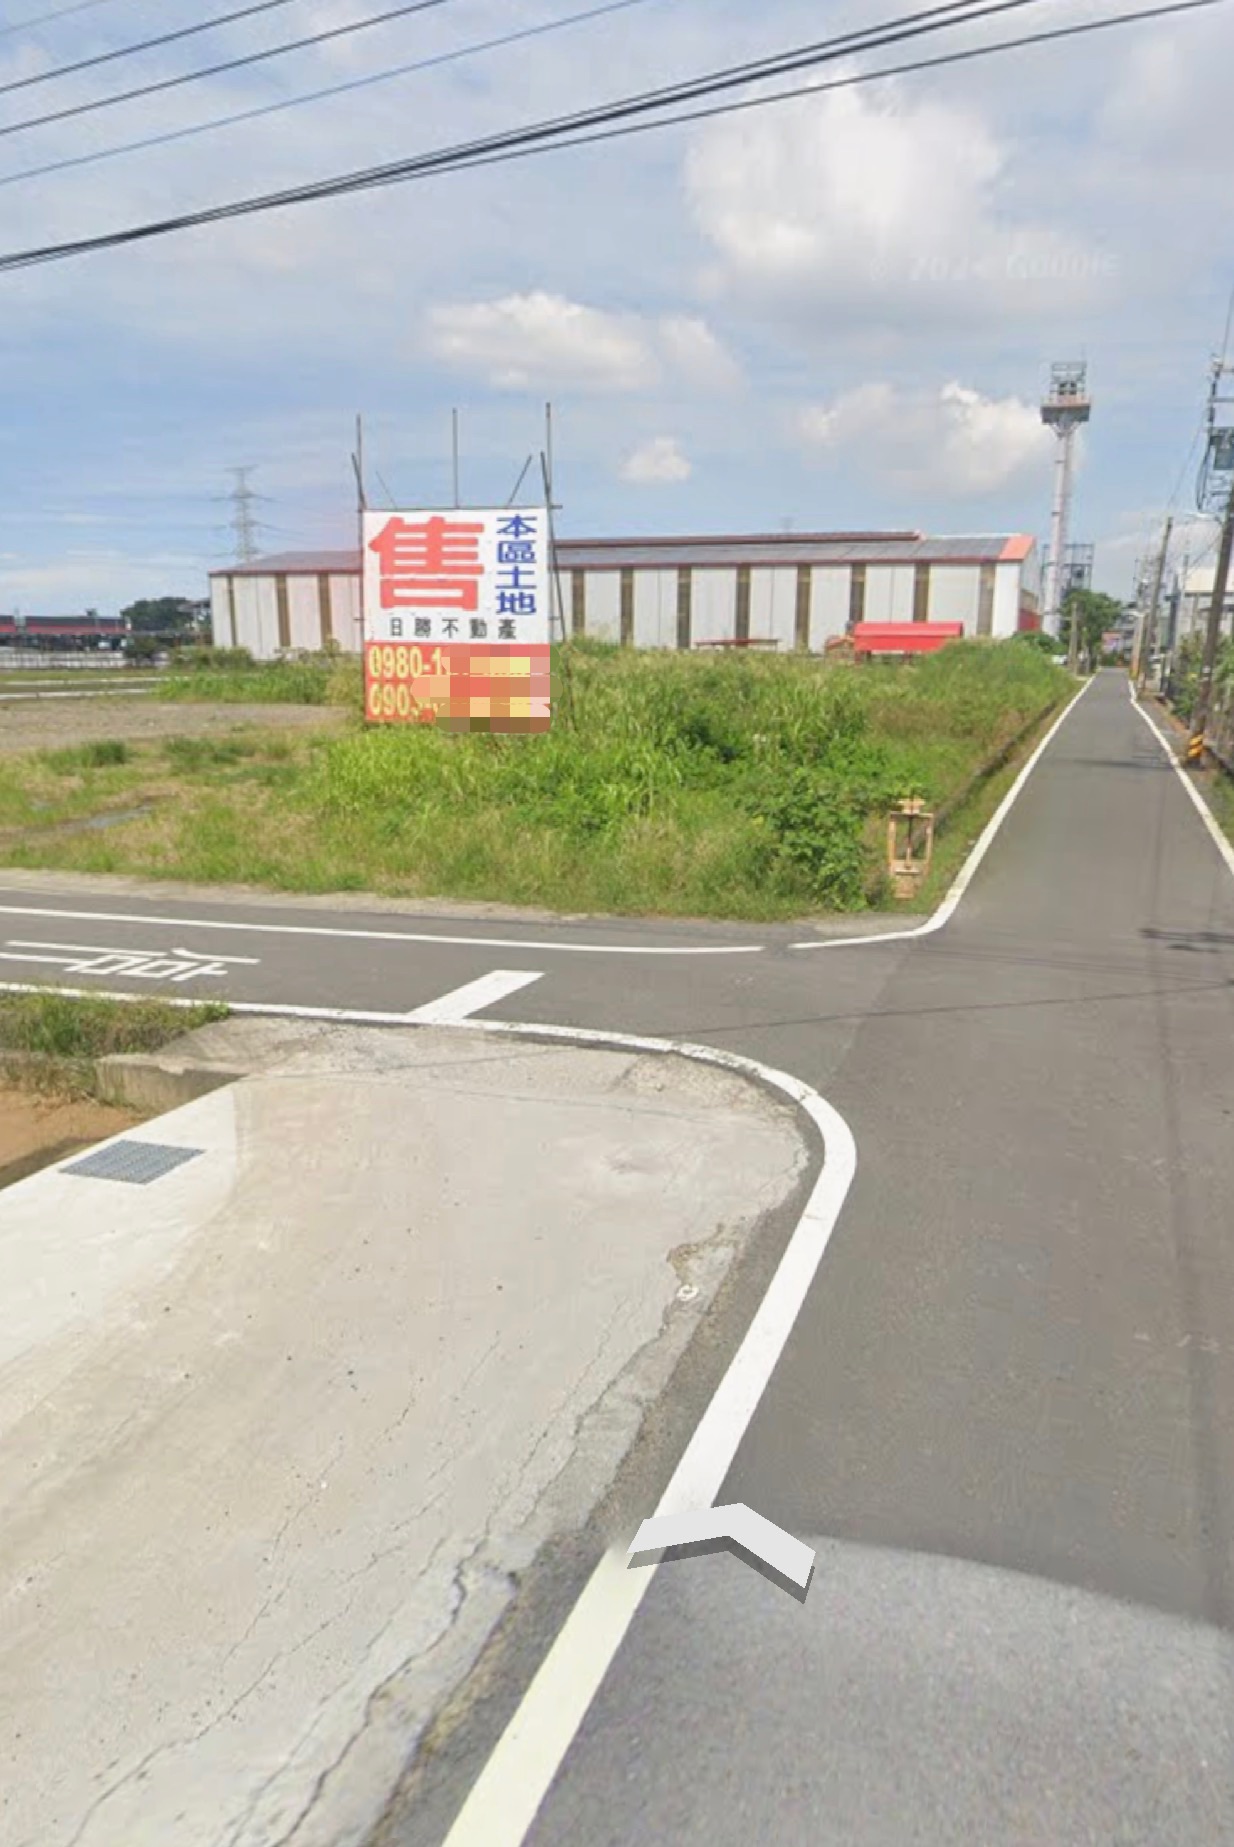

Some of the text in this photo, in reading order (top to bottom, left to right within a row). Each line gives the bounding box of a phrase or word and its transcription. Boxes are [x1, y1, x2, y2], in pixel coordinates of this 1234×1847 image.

[369, 516, 484, 611] 售
[495, 514, 537, 614] 本區土地
[390, 618, 516, 639] 日勝不動產
[0, 939, 260, 981] 停
